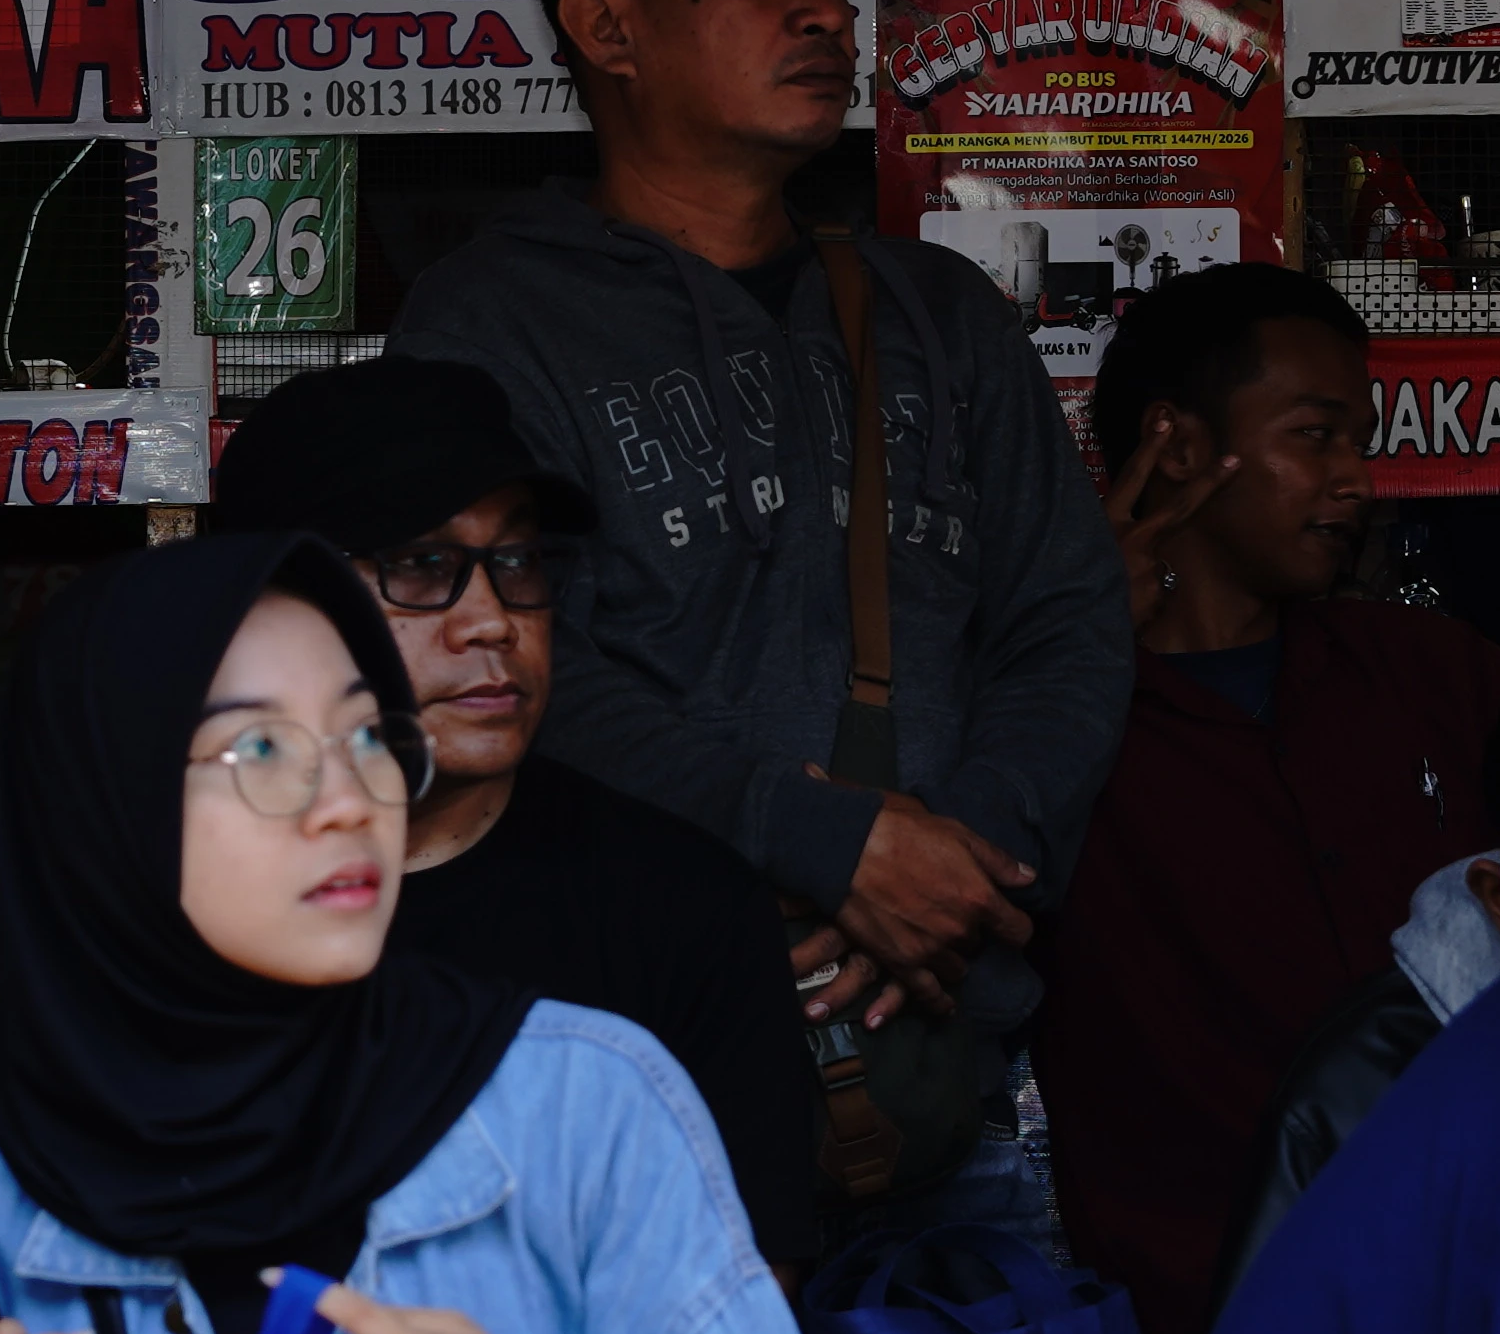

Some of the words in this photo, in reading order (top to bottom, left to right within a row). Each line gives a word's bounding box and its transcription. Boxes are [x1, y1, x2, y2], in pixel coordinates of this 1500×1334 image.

[202, 11, 529, 71] MUTIA
[1045, 73, 1072, 87] PO
[1076, 71, 1115, 87] BUS
[201, 82, 289, 118] HUB
[326, 80, 406, 117] 0813
[422, 78, 501, 115] 1488
[964, 91, 1193, 116] MAHARDHIKA
[911, 137, 954, 147] DALAM
[959, 137, 1010, 146] RANGKA
[1015, 135, 1097, 146] MENYAMBUT
[1098, 135, 1129, 145] IDUL
[1131, 134, 1167, 146] FITRI
[1172, 133, 1249, 145] 1447H/2026
[229, 148, 321, 183] LOKET
[224, 195, 329, 298] 26
